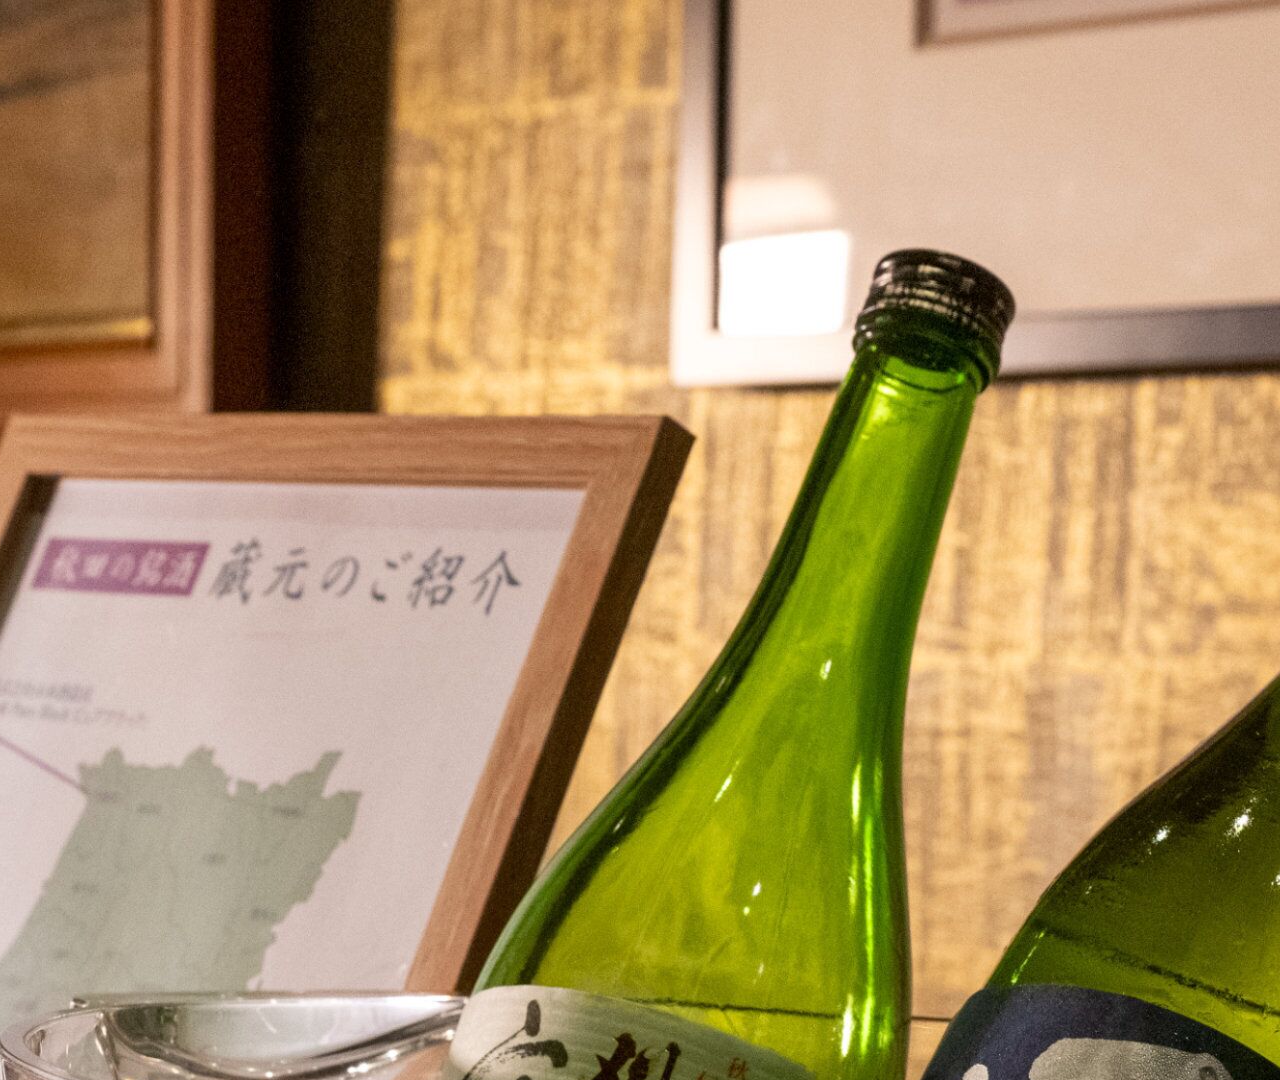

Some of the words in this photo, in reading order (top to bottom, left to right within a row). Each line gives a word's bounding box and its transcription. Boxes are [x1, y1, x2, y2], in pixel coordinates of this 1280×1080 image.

[52, 543, 196, 588] 秋田の銘酒
[210, 537, 521, 615] 蔵元のご紹介
